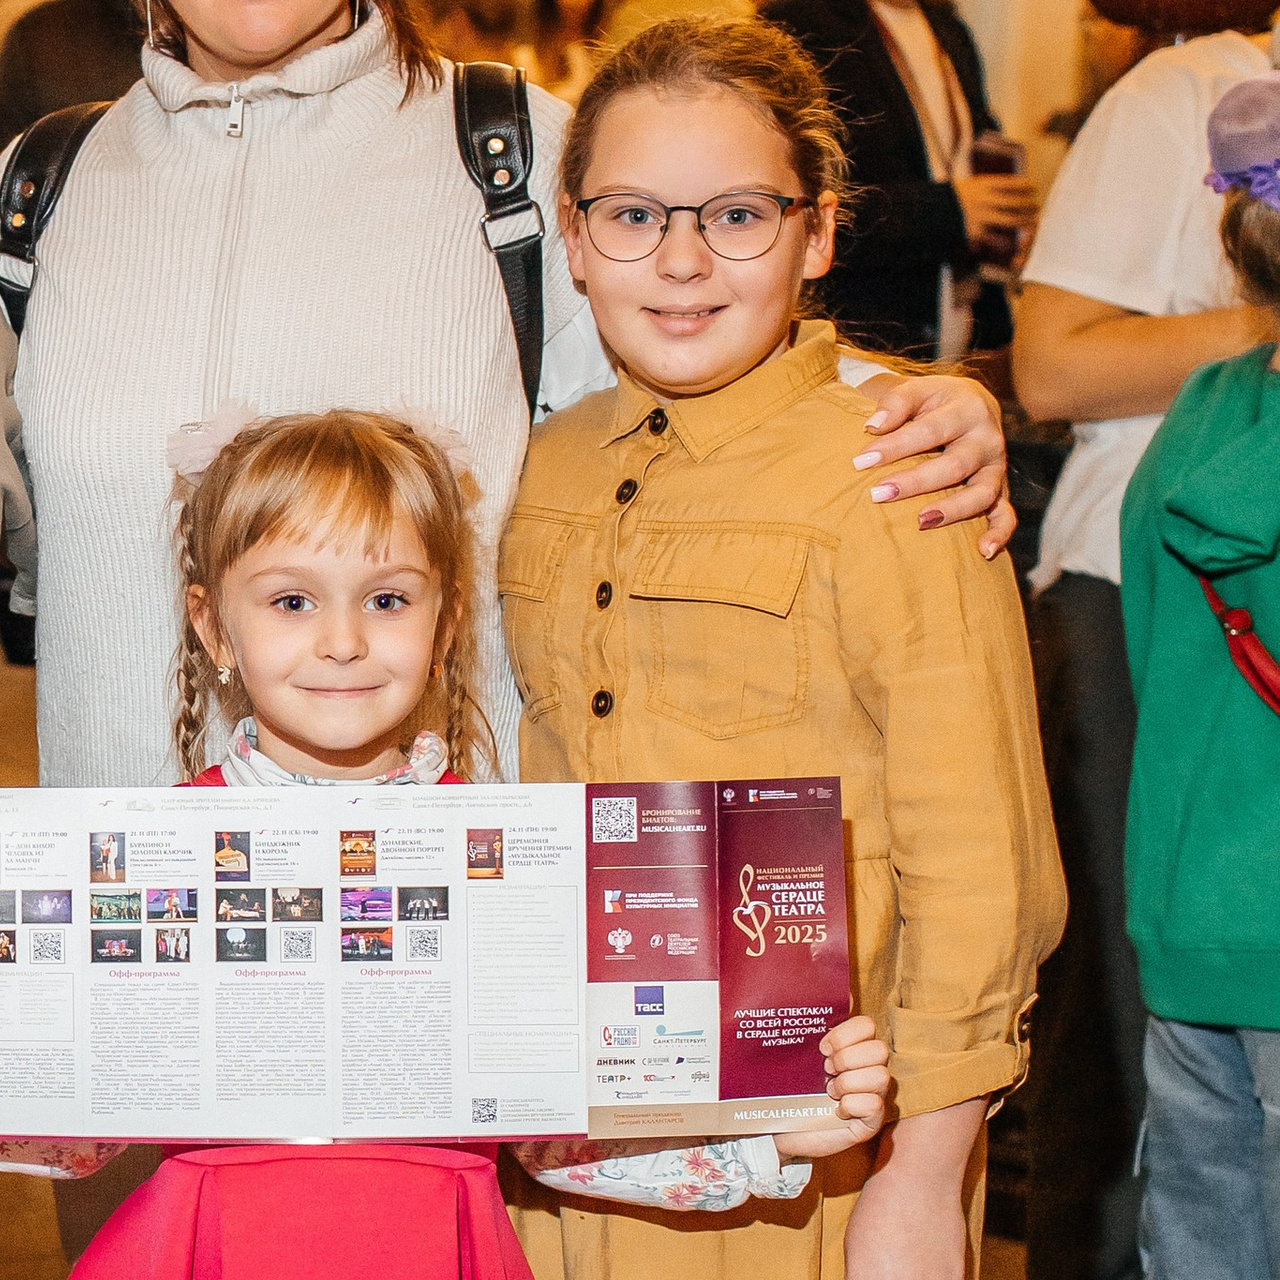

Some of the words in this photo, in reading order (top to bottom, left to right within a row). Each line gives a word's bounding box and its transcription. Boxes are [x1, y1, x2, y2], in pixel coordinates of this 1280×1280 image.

[641, 825, 707, 833] MUSICALHEART.RU
[756, 864, 824, 874] НАЦИОНАЛЬНЫЙ
[757, 881, 825, 891] МУЗЫКАЛЬНОЕ
[771, 890, 826, 903] СЕРДЦЕ
[772, 903, 826, 916] ТЕАТРА
[774, 924, 827, 944] 2025
[109, 969, 181, 979] Офф-программа
[235, 968, 307, 978] Офф-программа
[360, 968, 432, 978] Офф-программа
[734, 1008, 776, 1018] ЛУЧШИЕ
[777, 1007, 833, 1017] СПЕКТАКЛИ
[739, 1020, 754, 1029] СО
[756, 1018, 780, 1028] ВСЕЙ
[613, 1027, 637, 1036] РУССКОЕ
[736, 1031, 743, 1039] В
[745, 1029, 780, 1038] СЕРДЦЕ
[782, 1026, 826, 1036] КОТОРЫХ
[613, 1037, 631, 1045] РАДИО
[762, 1037, 804, 1047] МУЗЫКА!
[596, 1058, 636, 1066] ДНЕВНИК
[734, 1107, 832, 1121] MUSICALHEART.RU
